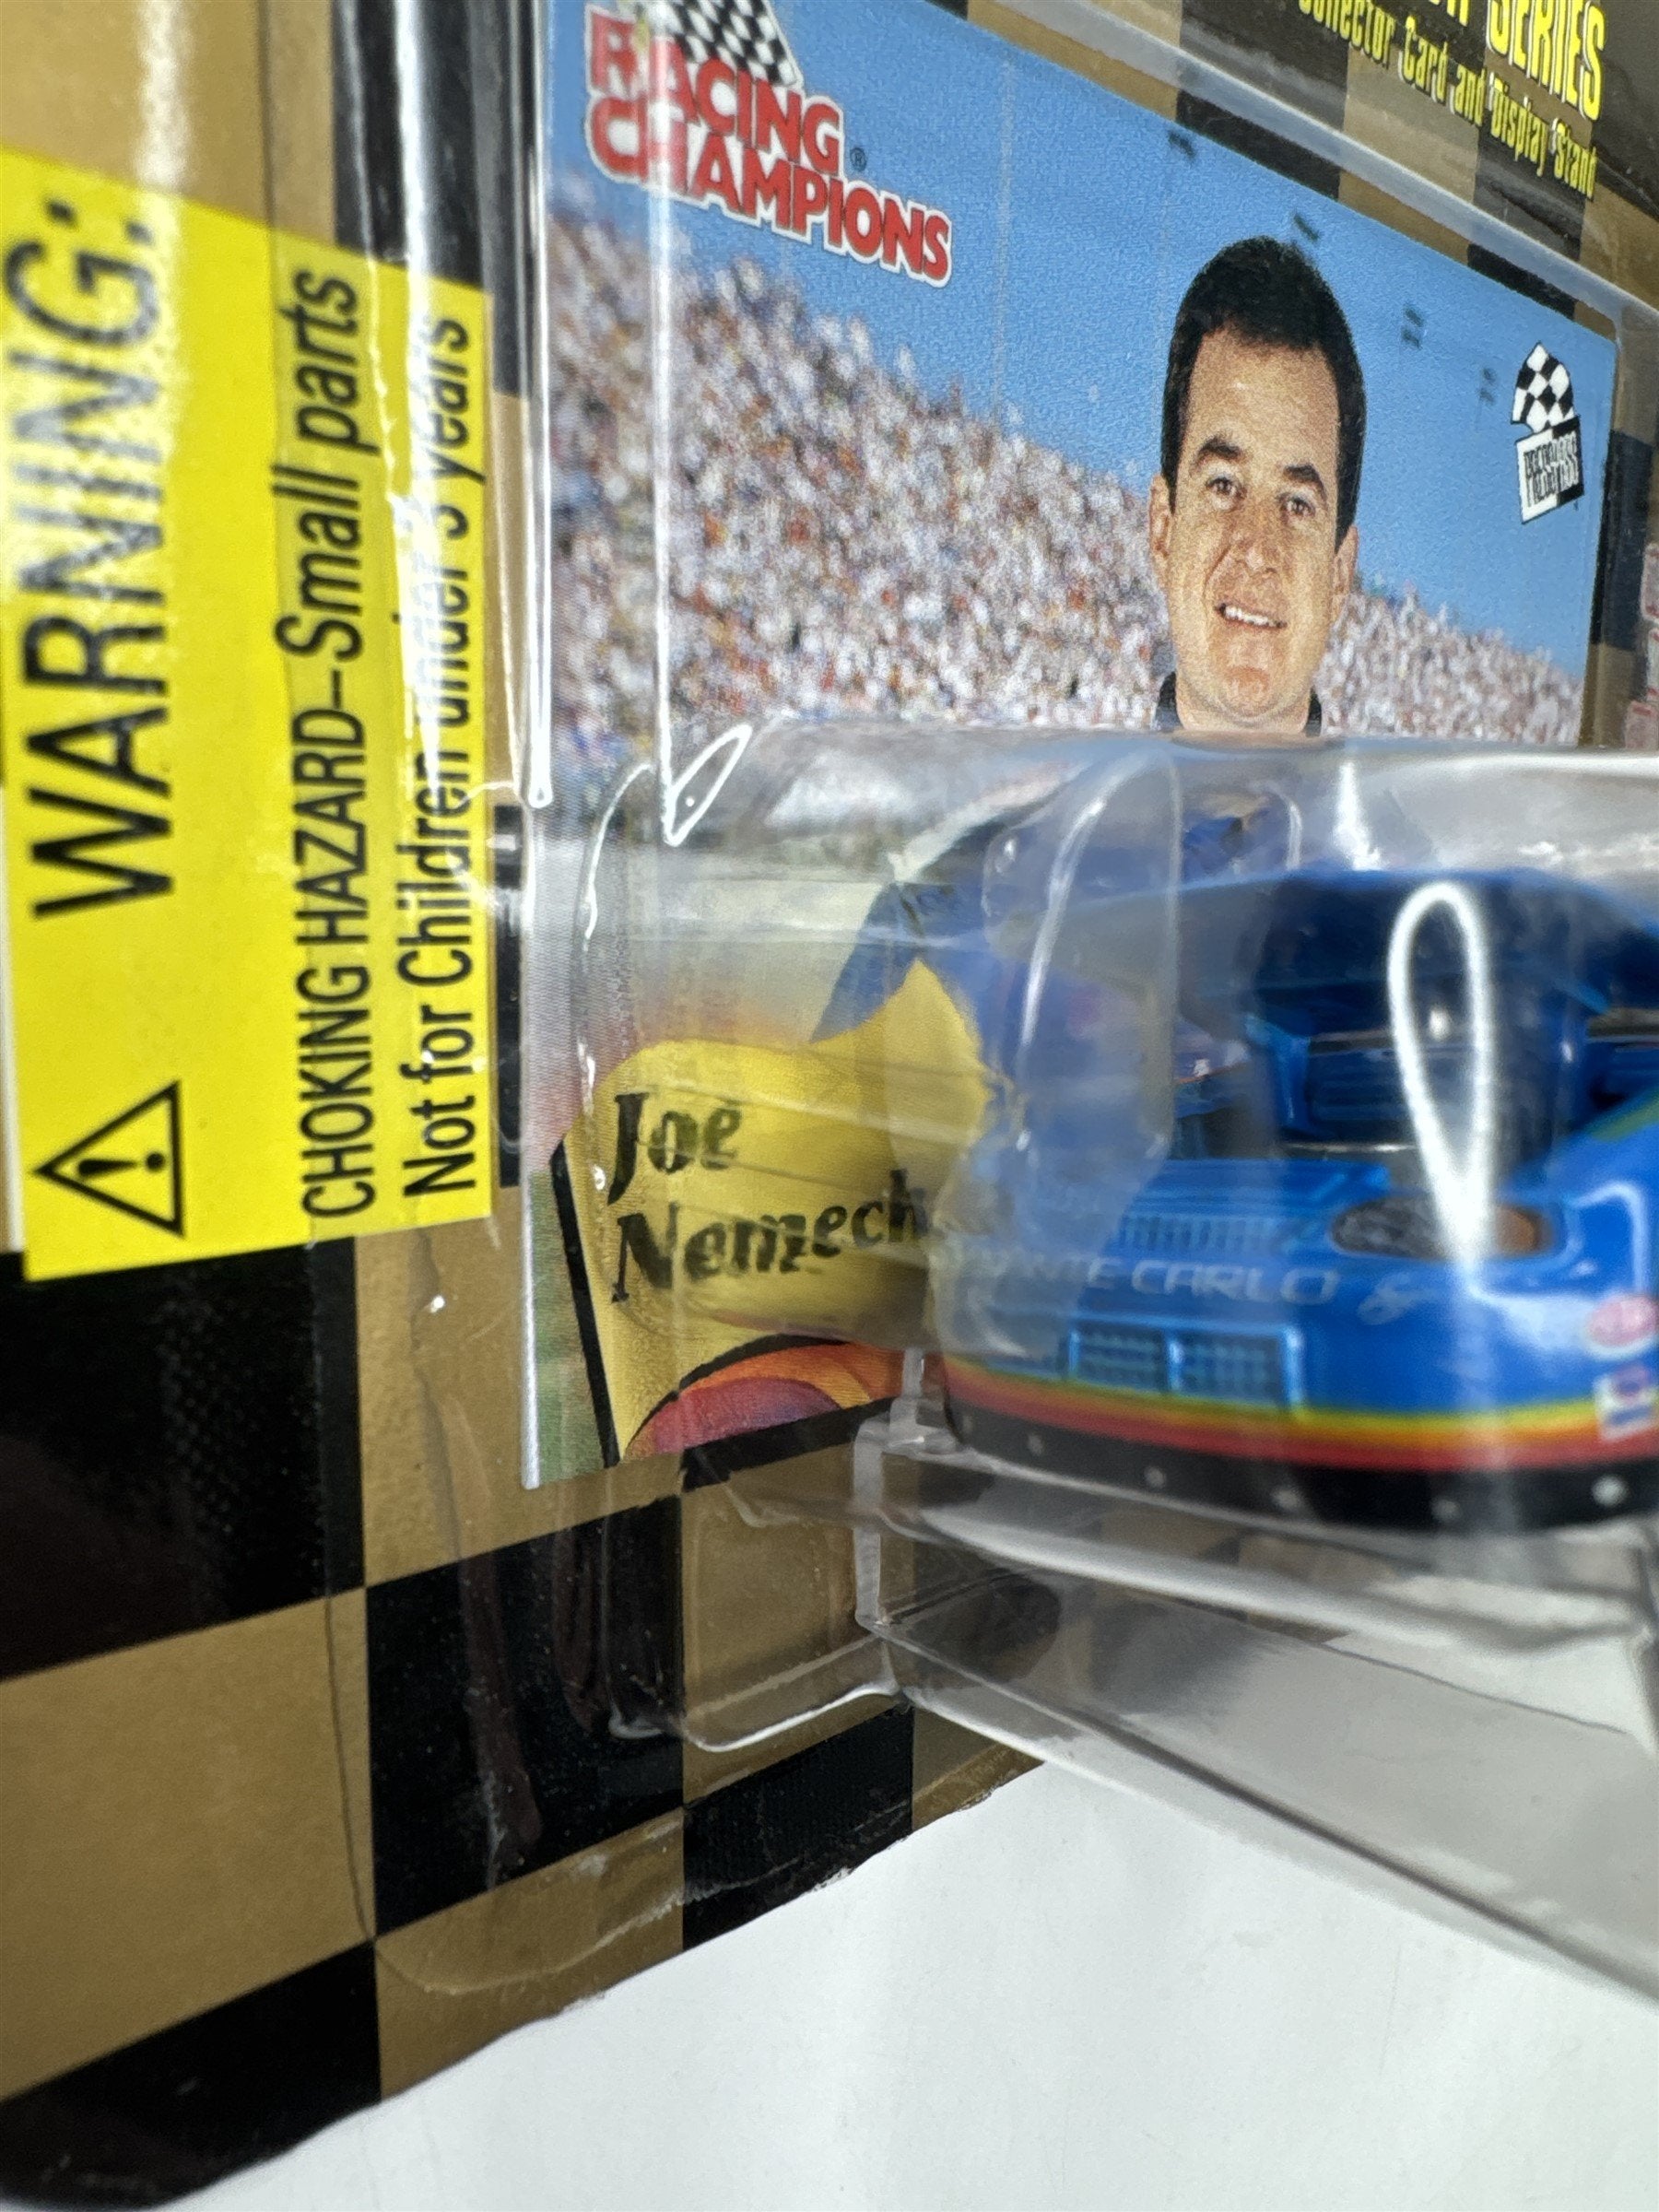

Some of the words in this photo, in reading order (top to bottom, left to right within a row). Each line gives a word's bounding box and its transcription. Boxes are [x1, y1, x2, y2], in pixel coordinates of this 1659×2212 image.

[591, 12, 841, 176] RACING
[1298, 0, 1396, 68] lector
[1398, 15, 1448, 105] Card
[1450, 63, 1488, 127] and
[1488, 71, 1548, 177] Display
[1549, 117, 1597, 200] Stand
[591, 95, 950, 282] CHAMPIONS
[278, 270, 380, 456] parts
[419, 318, 487, 486] years
[4, 194, 173, 920] WARNING:
[396, 751, 474, 987] Children
[294, 963, 376, 1218] CHOKING
[400, 1004, 476, 1081] for
[402, 1095, 477, 1198] Not
[607, 1092, 743, 1206] Joe
[1132, 1259, 1340, 1305] CARLO
